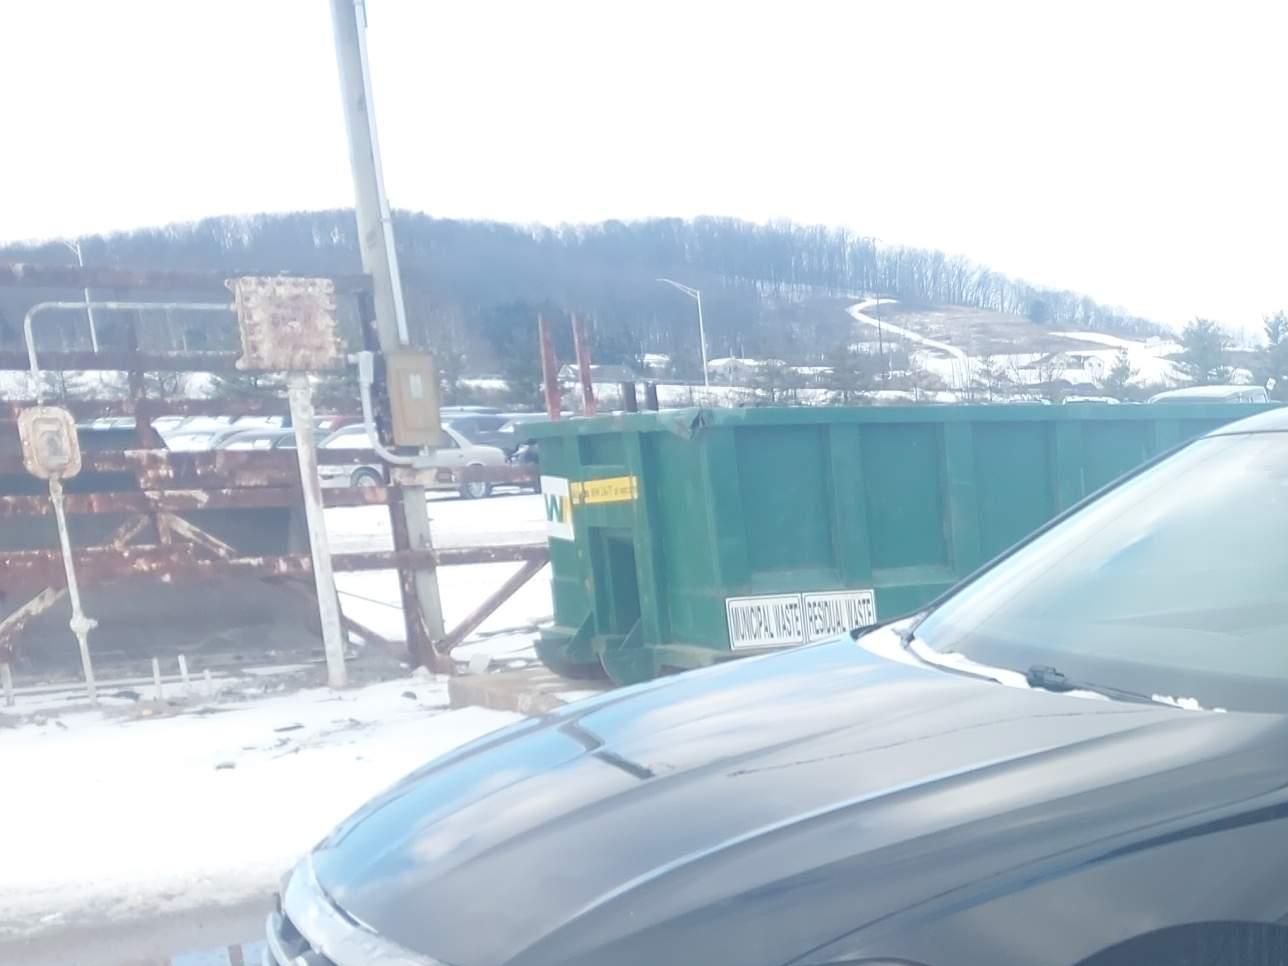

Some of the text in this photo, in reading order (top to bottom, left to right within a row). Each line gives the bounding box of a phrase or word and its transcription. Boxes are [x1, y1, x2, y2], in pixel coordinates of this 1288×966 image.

[731, 602, 801, 641] MUNICIPAL WASTE
[807, 598, 872, 637] RESIDUAL WASTE
